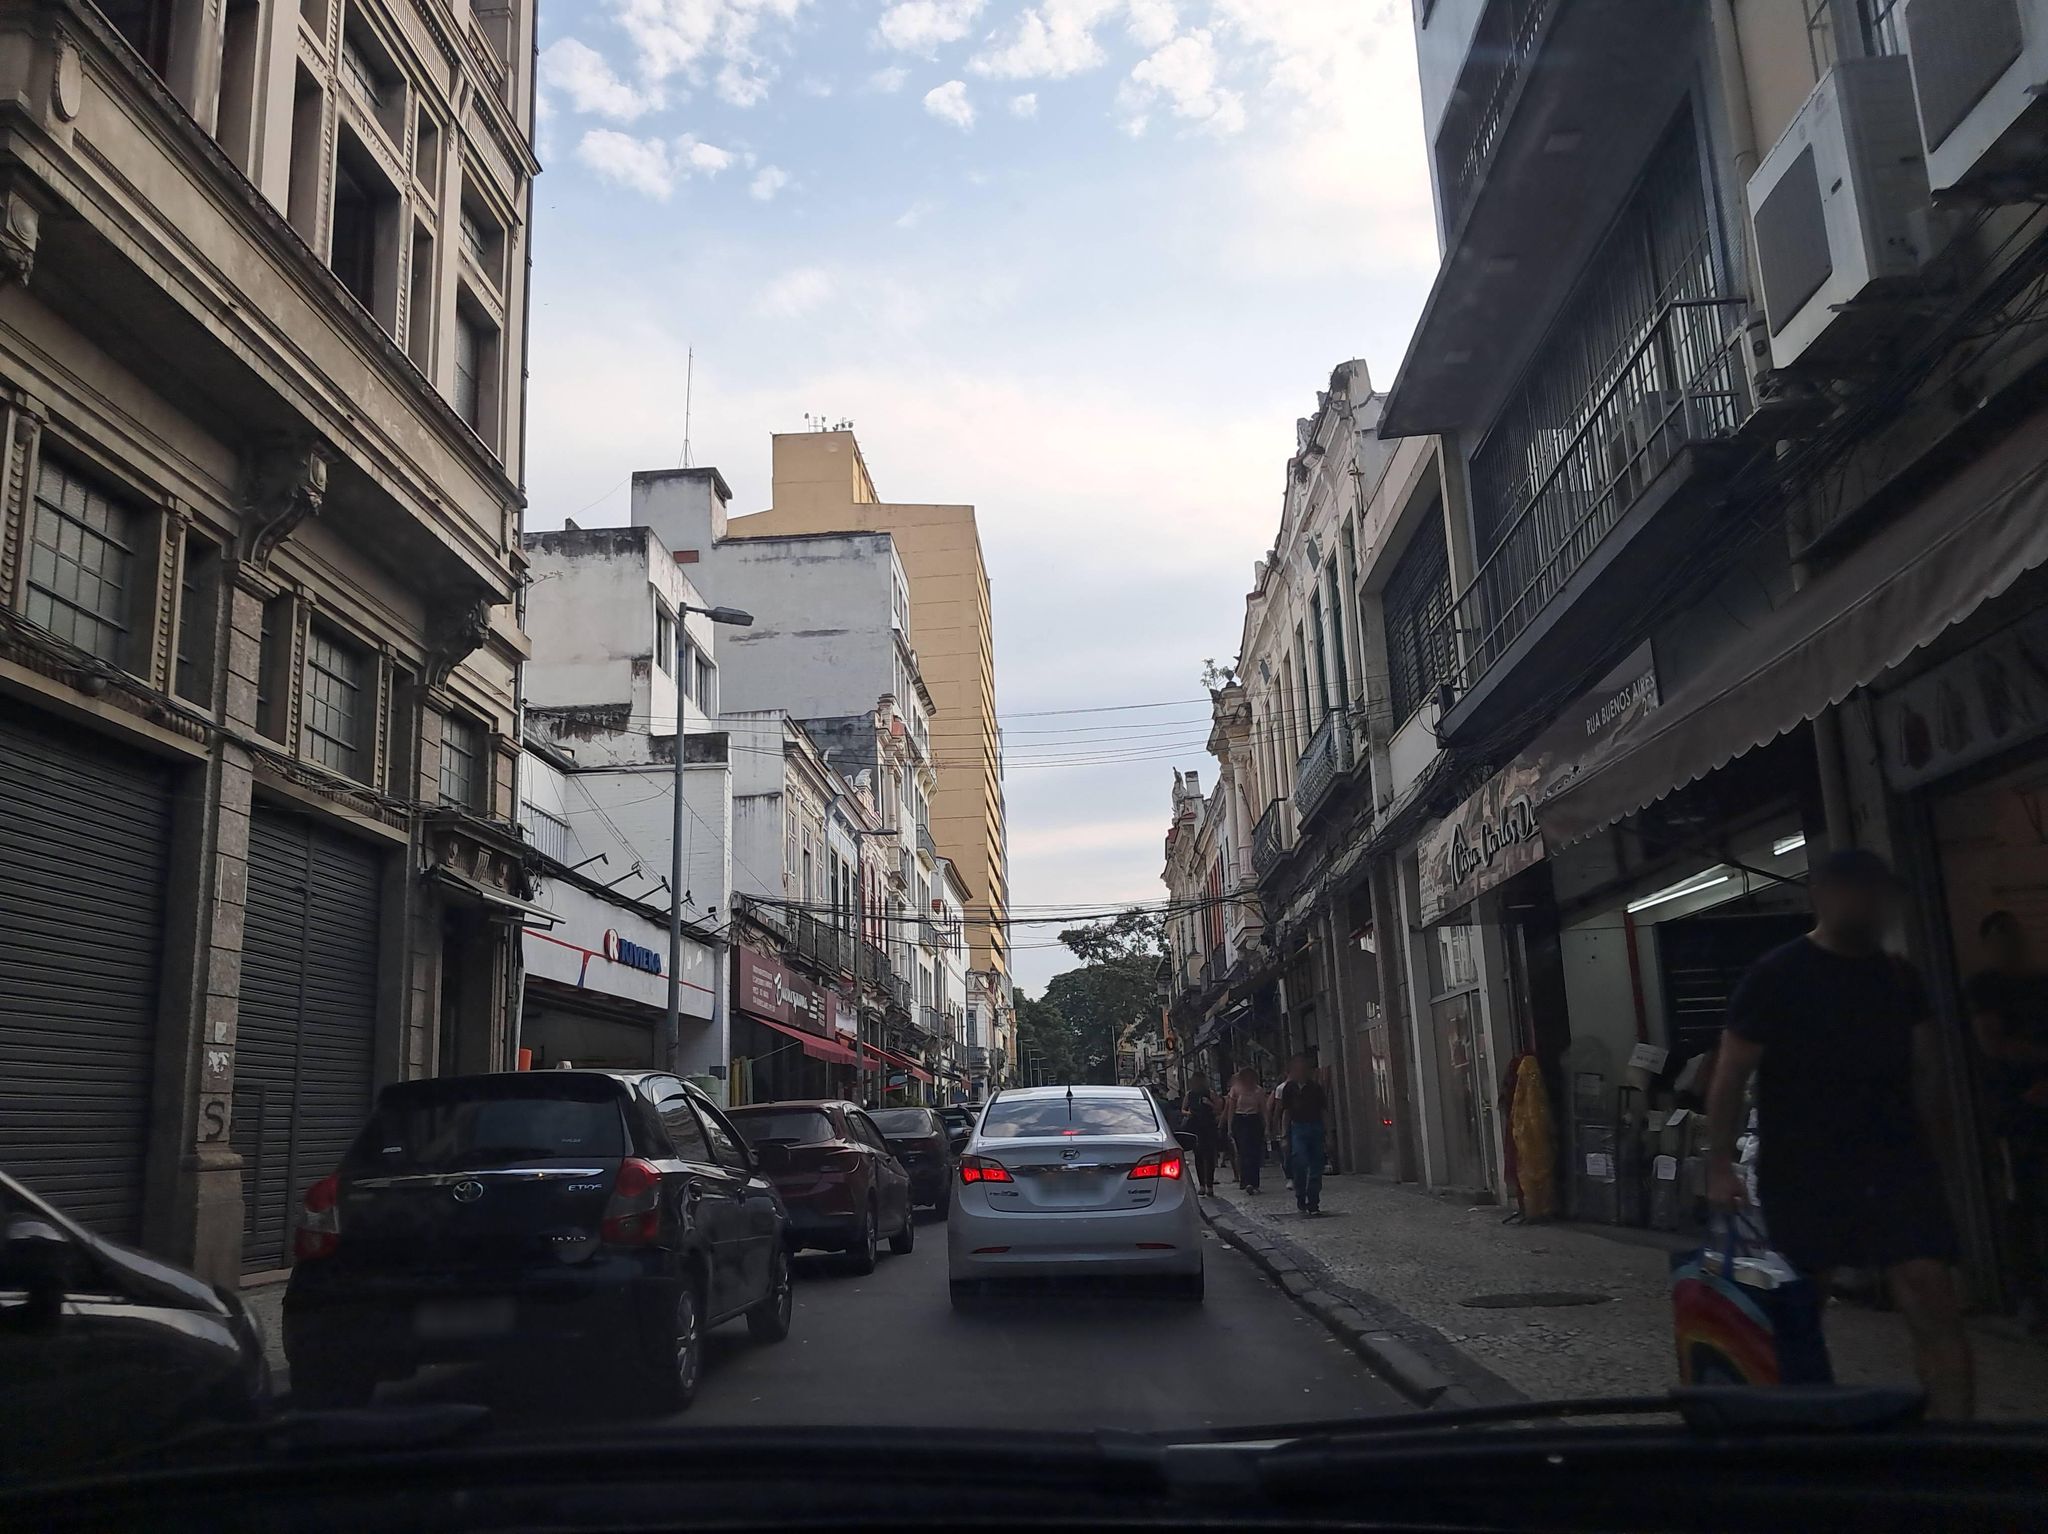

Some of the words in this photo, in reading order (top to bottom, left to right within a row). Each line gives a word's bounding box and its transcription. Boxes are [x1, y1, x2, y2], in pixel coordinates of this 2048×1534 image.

[1585, 711, 1601, 737] RUA
[1601, 687, 1631, 726] BUENOS
[1632, 675, 1655, 702] AIRES
[618, 938, 662, 975] RIVIERA
